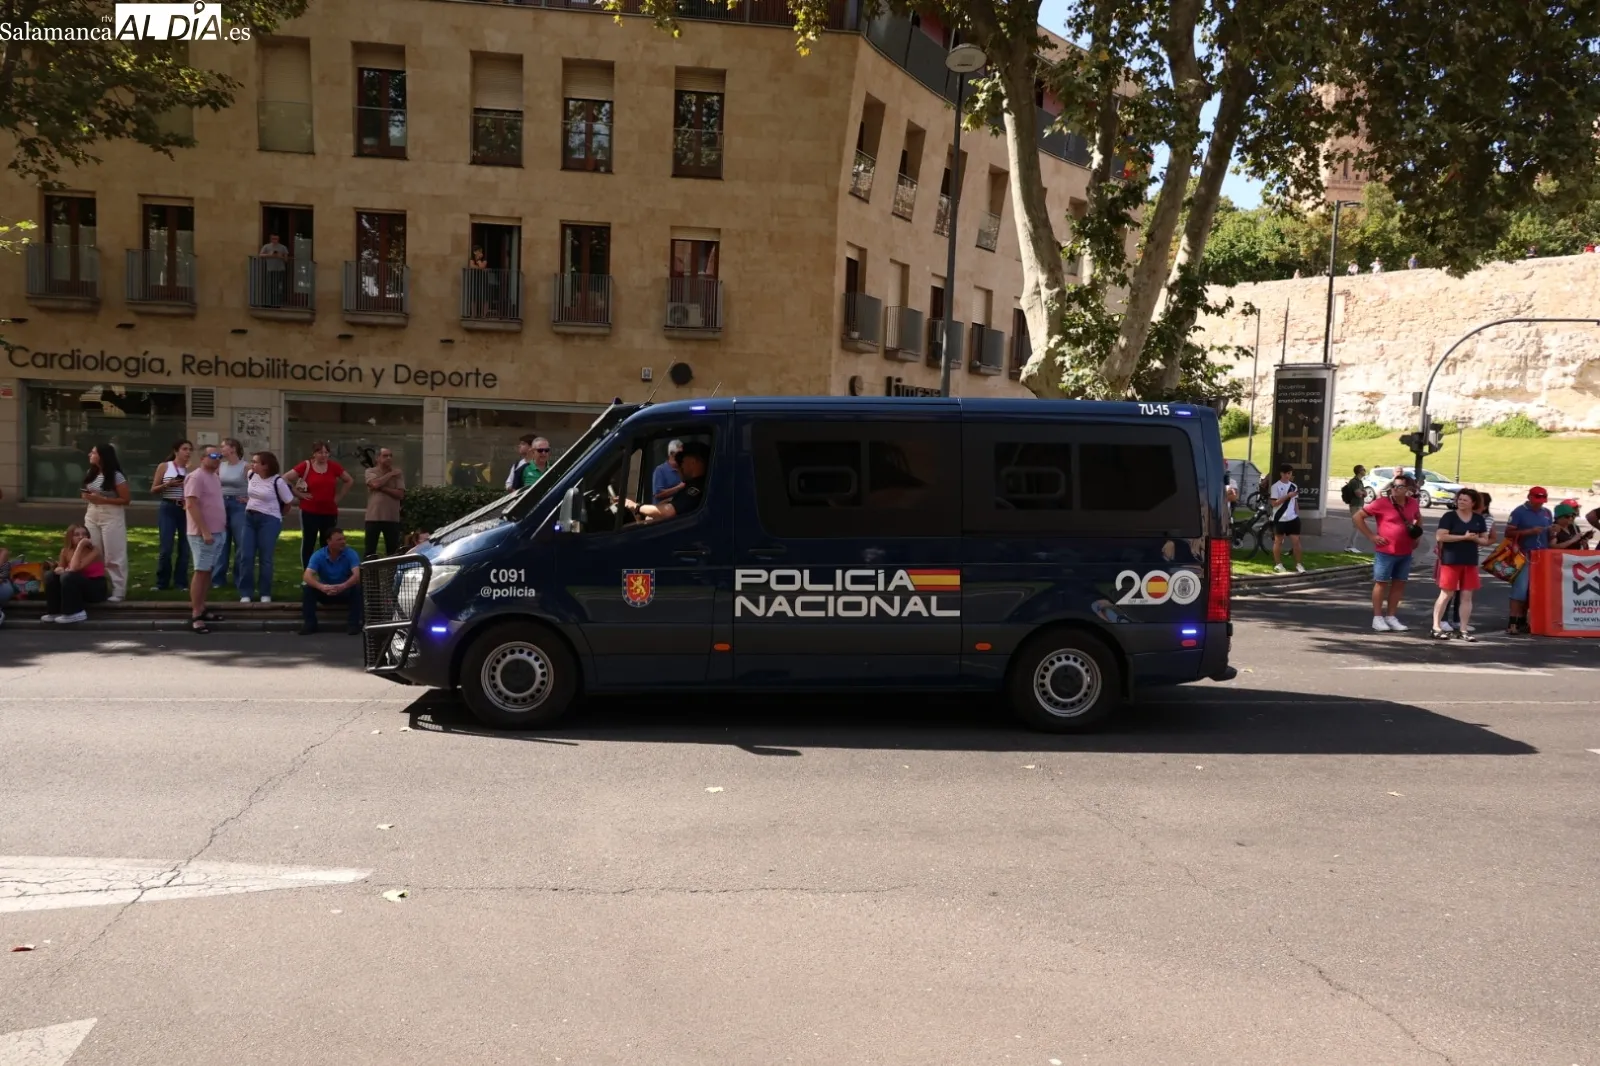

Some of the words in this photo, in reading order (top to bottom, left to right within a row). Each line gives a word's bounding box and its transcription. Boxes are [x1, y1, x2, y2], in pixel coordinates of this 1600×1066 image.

[8, 346, 172, 378] Cardiología,
[182, 354, 362, 384] Rehabilitación
[371, 367, 385, 388] y
[394, 363, 497, 391] Deporte
[498, 568, 525, 583] 091
[480, 586, 536, 600] @policia
[1115, 569, 1201, 605] 200
[735, 595, 961, 617] NACIONAL
